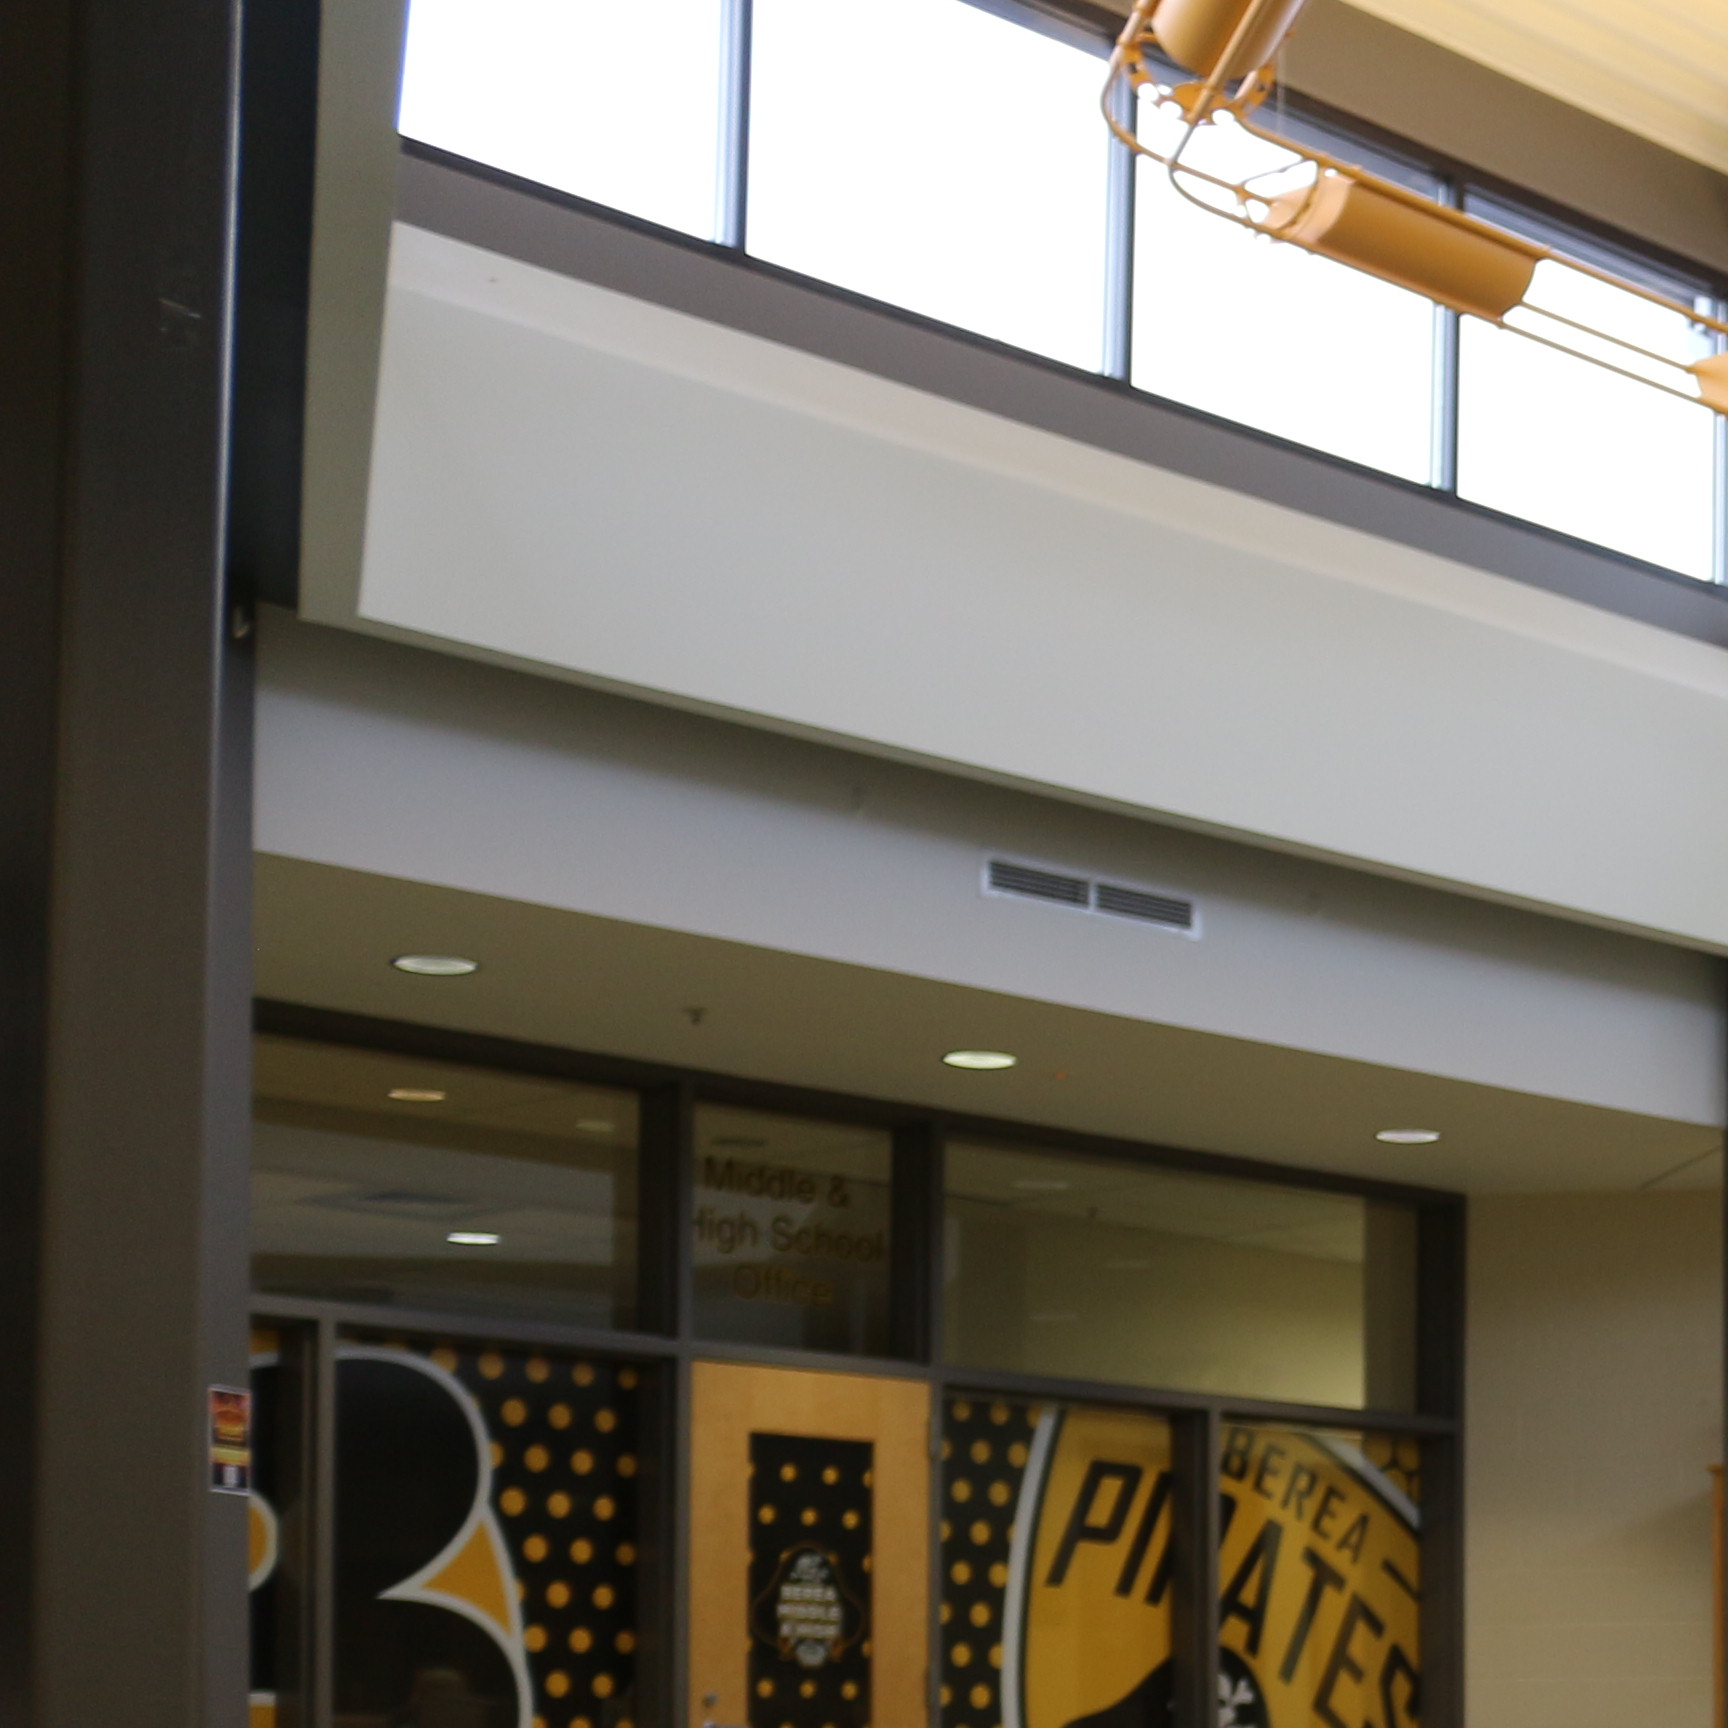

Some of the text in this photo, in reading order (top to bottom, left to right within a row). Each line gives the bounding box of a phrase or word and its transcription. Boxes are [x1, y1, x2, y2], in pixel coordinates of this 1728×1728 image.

[703, 1155, 850, 1208] Middle &
[770, 1214, 885, 1262] School
[733, 1264, 834, 1308] Office
[1221, 1425, 1370, 1564] BEREA
